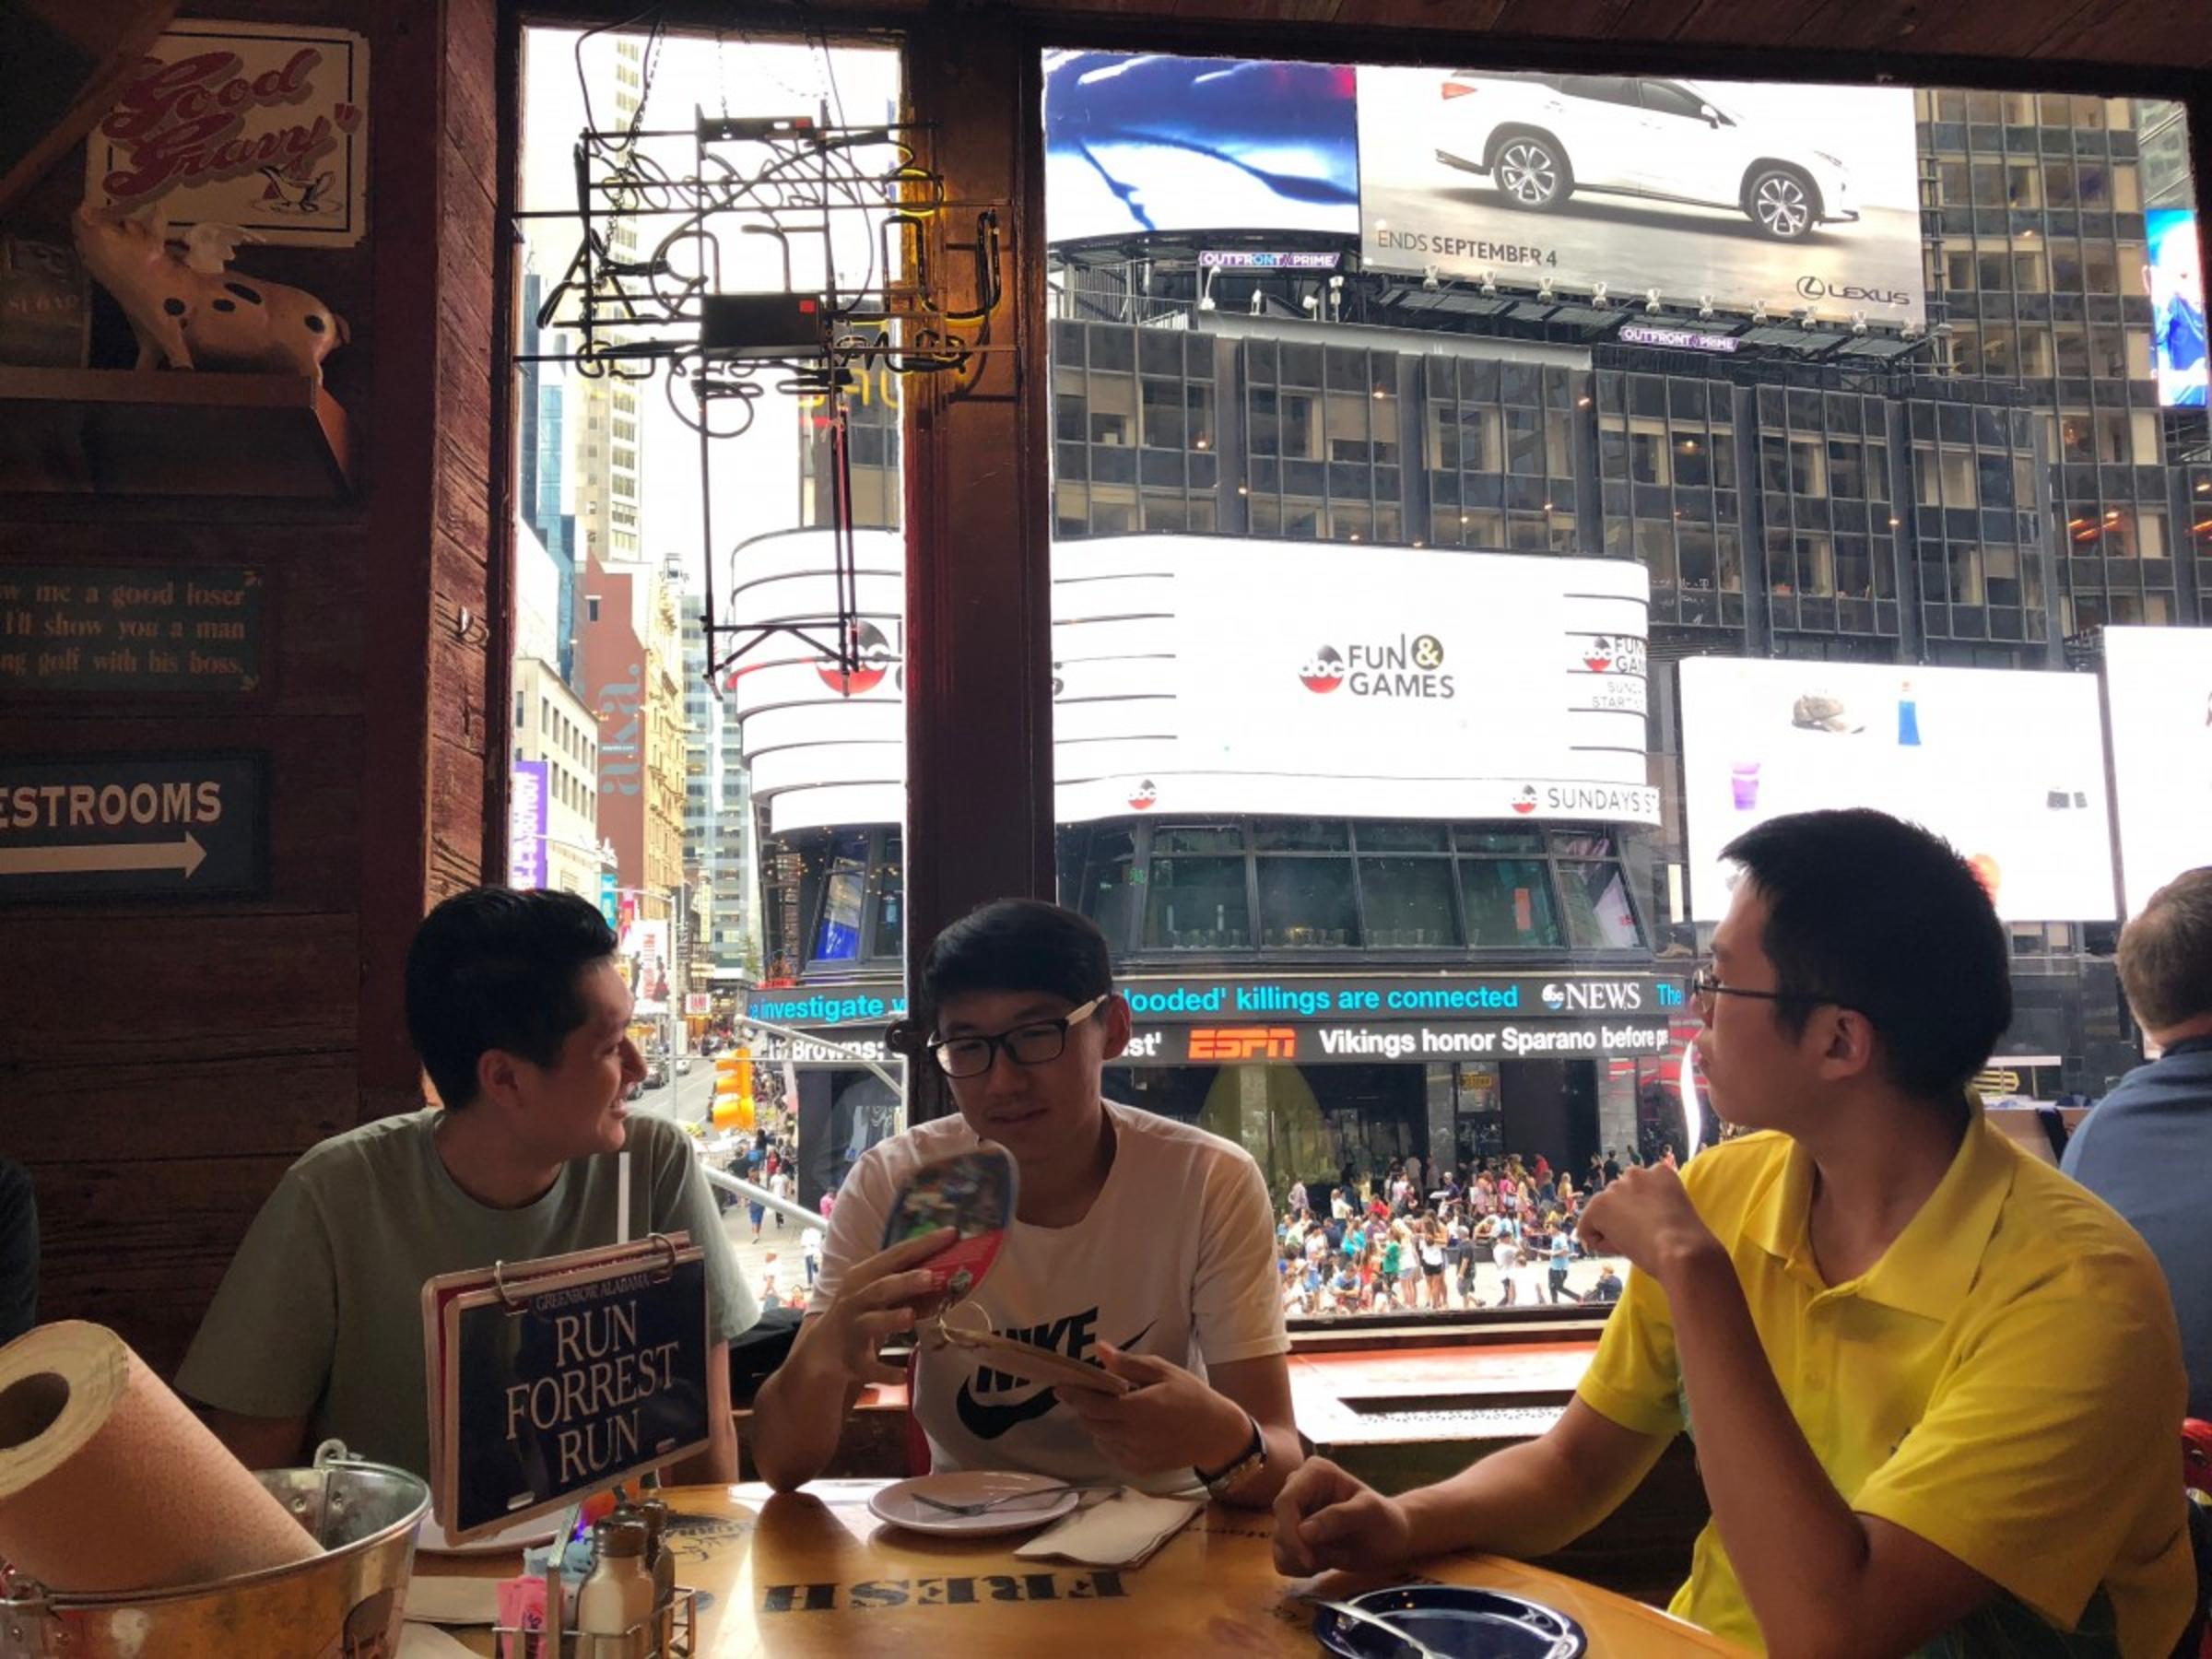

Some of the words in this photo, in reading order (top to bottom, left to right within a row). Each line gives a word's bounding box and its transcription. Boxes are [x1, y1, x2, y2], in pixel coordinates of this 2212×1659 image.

[102, 47, 323, 138] Good
[1203, 253, 1283, 267] OUTFRONT
[1293, 253, 1334, 267] PRIME
[1377, 229, 1428, 252] ENDS
[1431, 236, 1542, 266] SEPTEMBER
[1546, 250, 1558, 268] 4
[1828, 283, 1911, 305] LEXUS
[36, 582, 72, 604] me
[85, 582, 100, 604] a
[111, 580, 178, 609] good
[186, 581, 247, 607] loser
[43, 610, 103, 637] show
[118, 618, 159, 642] you
[169, 619, 184, 638] a
[195, 618, 247, 641] man
[38, 645, 82, 678] golf
[92, 646, 138, 674] with
[148, 647, 179, 675] his
[1347, 632, 1406, 670] FUN
[1411, 634, 1444, 671] &
[1348, 672, 1455, 700] GAMES
[1548, 787, 1640, 812] SUNDAYS
[760, 994, 885, 1023] investigate
[1236, 986, 1331, 1015] killings
[1337, 990, 1380, 1010] are
[1386, 984, 1519, 1010] connected
[1565, 982, 1641, 1010] NEWS
[1656, 983, 1683, 1006] The
[1189, 1028, 1297, 1059] ESPN
[1319, 1028, 1417, 1059] Vikings
[1421, 1027, 1496, 1053] honor
[1501, 1025, 1596, 1056] Sparano
[1601, 1025, 1655, 1049] before
[555, 1300, 638, 1368] RUN
[505, 1341, 679, 1441] FORREST
[559, 1408, 641, 1484] RUN
[763, 1571, 1132, 1613] FRESH
